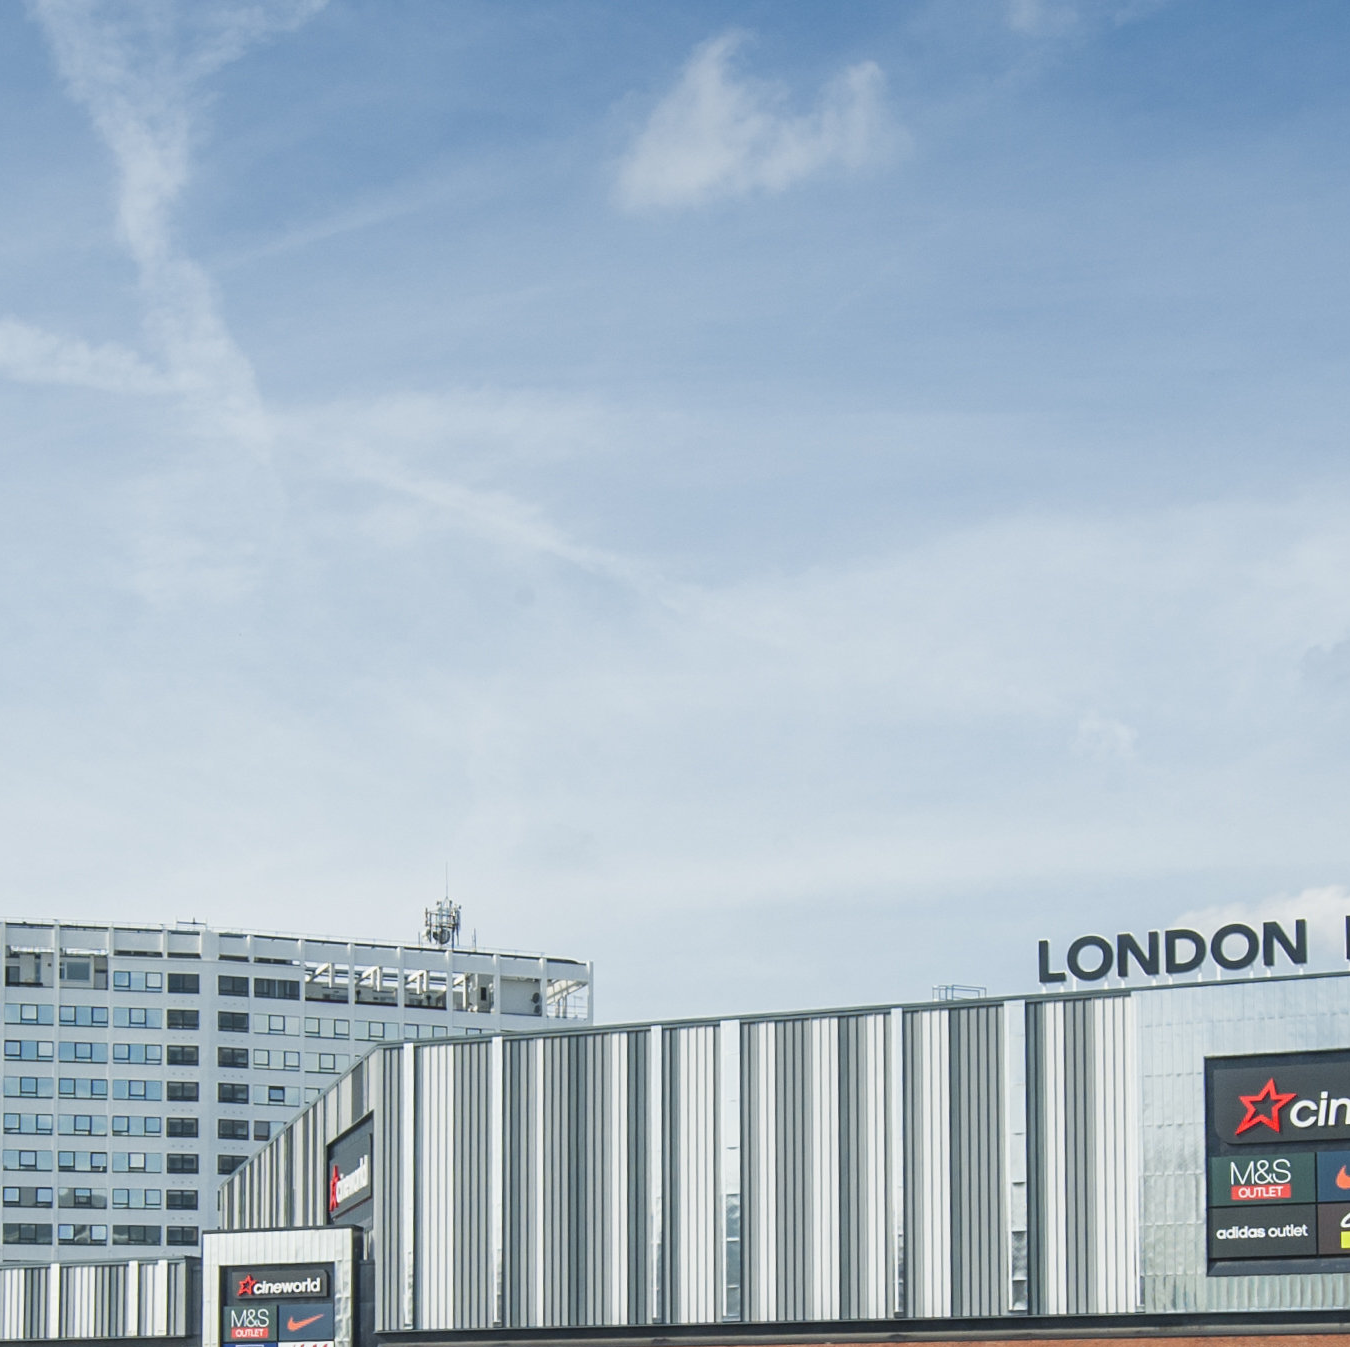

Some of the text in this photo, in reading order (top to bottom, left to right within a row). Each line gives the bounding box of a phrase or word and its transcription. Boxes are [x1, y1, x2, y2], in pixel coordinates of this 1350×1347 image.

[1039, 918, 1307, 984] LONDON
[1230, 1159, 1292, 1186] M&S
[1238, 1185, 1284, 1199] OUTLET
[1216, 1223, 1309, 1240] adidas outlet
[253, 1277, 321, 1295] cineworld
[231, 1308, 270, 1328] M&S
[235, 1328, 264, 1338] OUTLET
